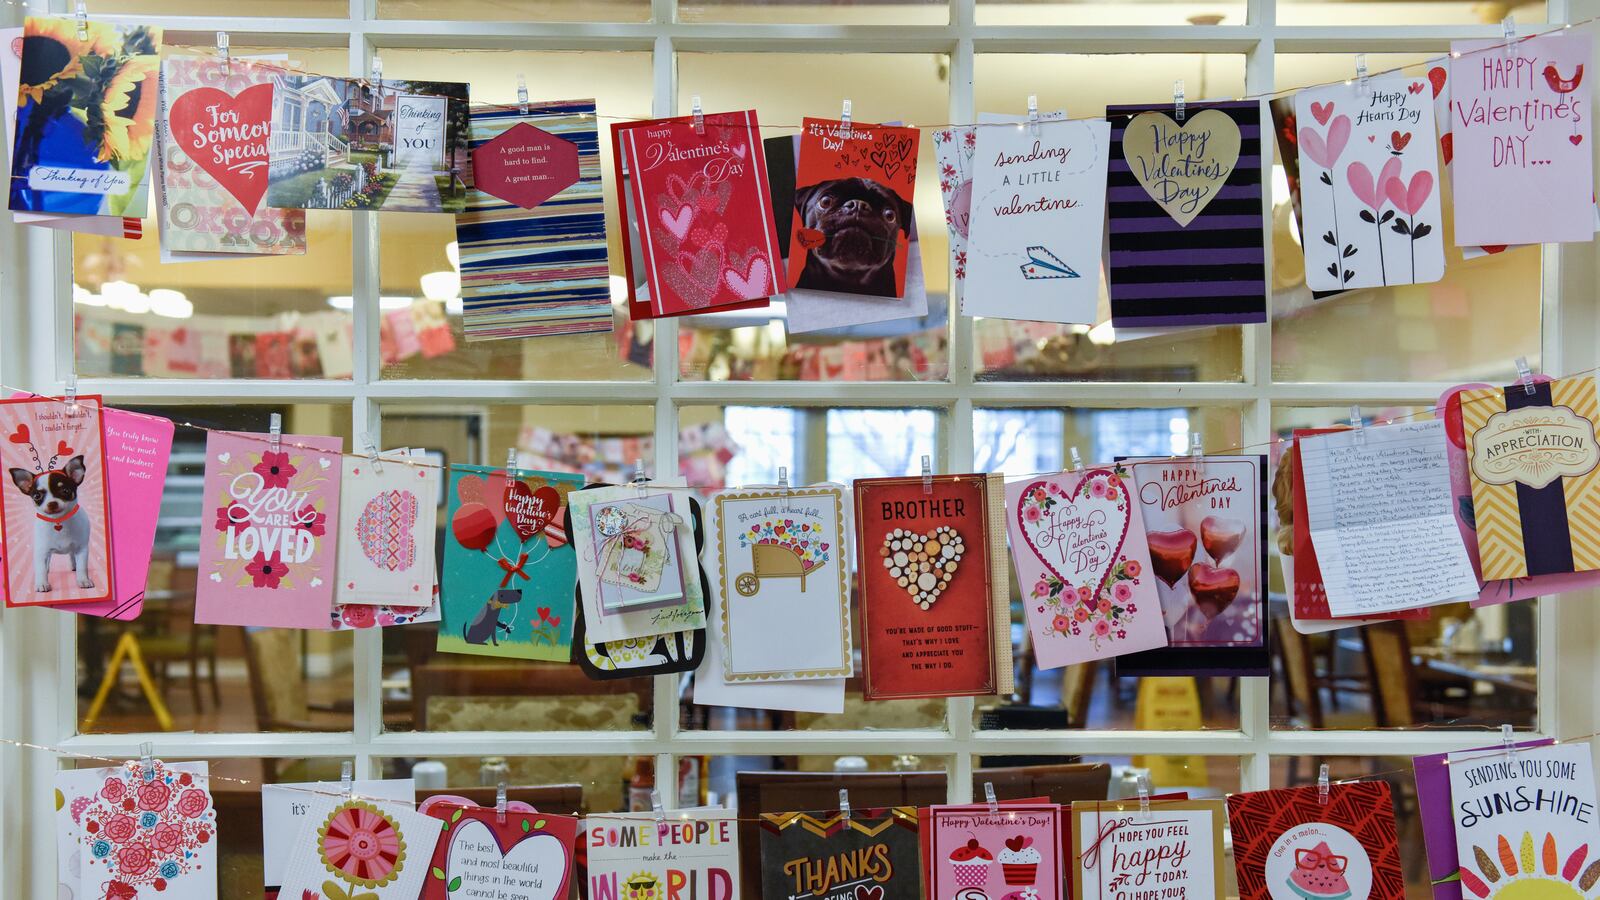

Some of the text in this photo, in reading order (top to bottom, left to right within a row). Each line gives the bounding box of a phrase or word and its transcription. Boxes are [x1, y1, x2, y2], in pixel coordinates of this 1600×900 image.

[1482, 57, 1537, 91] HAPPY
[1370, 91, 1407, 107] Happy
[205, 103, 240, 127] For
[400, 104, 442, 121] Thinking
[1356, 107, 1422, 126] Hearts Day
[1457, 97, 1582, 132] Valentine's
[415, 122, 426, 135] of
[646, 128, 672, 138] happy
[809, 123, 824, 136] It's
[403, 138, 436, 149] YOU
[823, 137, 844, 152] Day!
[1151, 123, 1211, 157] Happy
[213, 136, 271, 166] Special
[500, 146, 507, 154] A
[508, 146, 525, 155] good
[642, 141, 730, 172] Valentine's
[994, 140, 1071, 167] sending
[504, 157, 520, 165] hard
[531, 156, 548, 164] find.
[1137, 154, 1229, 183] Valentine's
[703, 156, 745, 184] Day
[1003, 170, 1061, 186] A LITTLE
[35, 167, 125, 192] Thinking of You
[505, 175, 512, 183] A
[513, 174, 531, 184] great
[1154, 178, 1209, 213] Day
[107, 426, 159, 443] You truly know
[121, 442, 157, 456] how much
[1486, 434, 1584, 460] APPRECIATION
[111, 455, 154, 468] and kindness
[1162, 469, 1198, 481] HAPPY
[227, 472, 317, 525] You
[509, 488, 544, 511] Happy
[1140, 477, 1242, 511] Valentine's
[1211, 497, 1231, 508] DAY
[505, 502, 551, 520] Valentine's
[738, 512, 749, 523] A
[749, 510, 762, 519] cart
[763, 506, 779, 518] full,
[786, 506, 804, 515] heart
[880, 498, 966, 521] BROTHER
[264, 514, 290, 526] ARE
[517, 514, 537, 531] Day
[1036, 505, 1084, 548] Happy
[224, 526, 316, 564] LOVED
[1058, 518, 1108, 564] Valentine's
[1069, 541, 1111, 574] Day
[885, 627, 906, 635] YOU'RE
[908, 626, 924, 634] MADE
[902, 638, 922, 646] THAT'S
[916, 649, 949, 657] APPRECIATE
[1464, 759, 1577, 788] SENDING YOU SOME
[291, 802, 306, 816] it's
[1460, 785, 1594, 828] SUNSHINE
[941, 816, 1051, 828] Happy Valentine's Day!
[591, 820, 730, 848] SOME PEOPLE
[1111, 826, 1189, 843] I HOPE YOU FEEL
[459, 840, 494, 853] The best
[1274, 845, 1286, 857] One
[1283, 838, 1292, 847] in
[642, 851, 678, 862] make the
[1111, 840, 1191, 886] happy
[461, 858, 539, 874] and most beautiful
[783, 843, 893, 896] THANKS
[464, 871, 543, 889] things in the world
[1155, 870, 1189, 883] TODAY.
[466, 888, 495, 899] cannot
[498, 889, 508, 900] be
[1136, 890, 1159, 900] HOPE
[1161, 887, 1186, 900] YOUR
